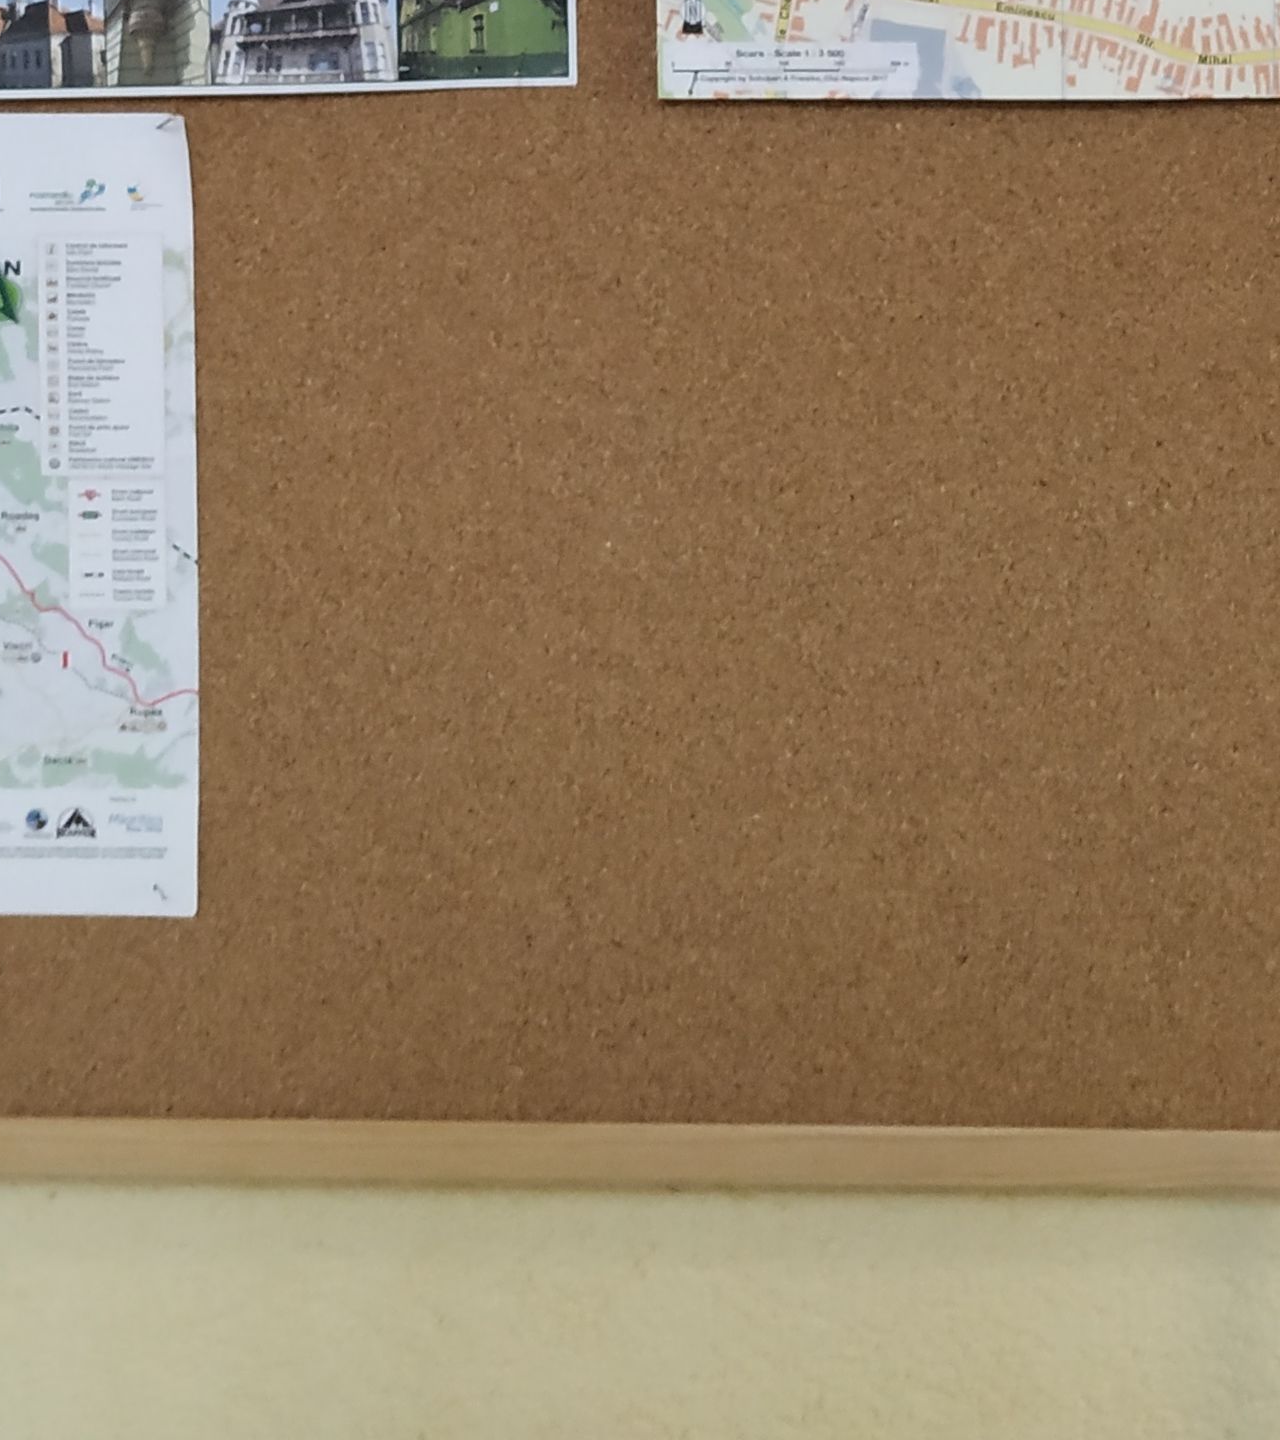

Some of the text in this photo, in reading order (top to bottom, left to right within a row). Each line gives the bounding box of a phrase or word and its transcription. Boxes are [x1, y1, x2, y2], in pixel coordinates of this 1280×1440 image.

[996, 2, 1056, 22] Eminescu
[1198, 54, 1233, 66] Mihai
[4, 260, 21, 275] N
